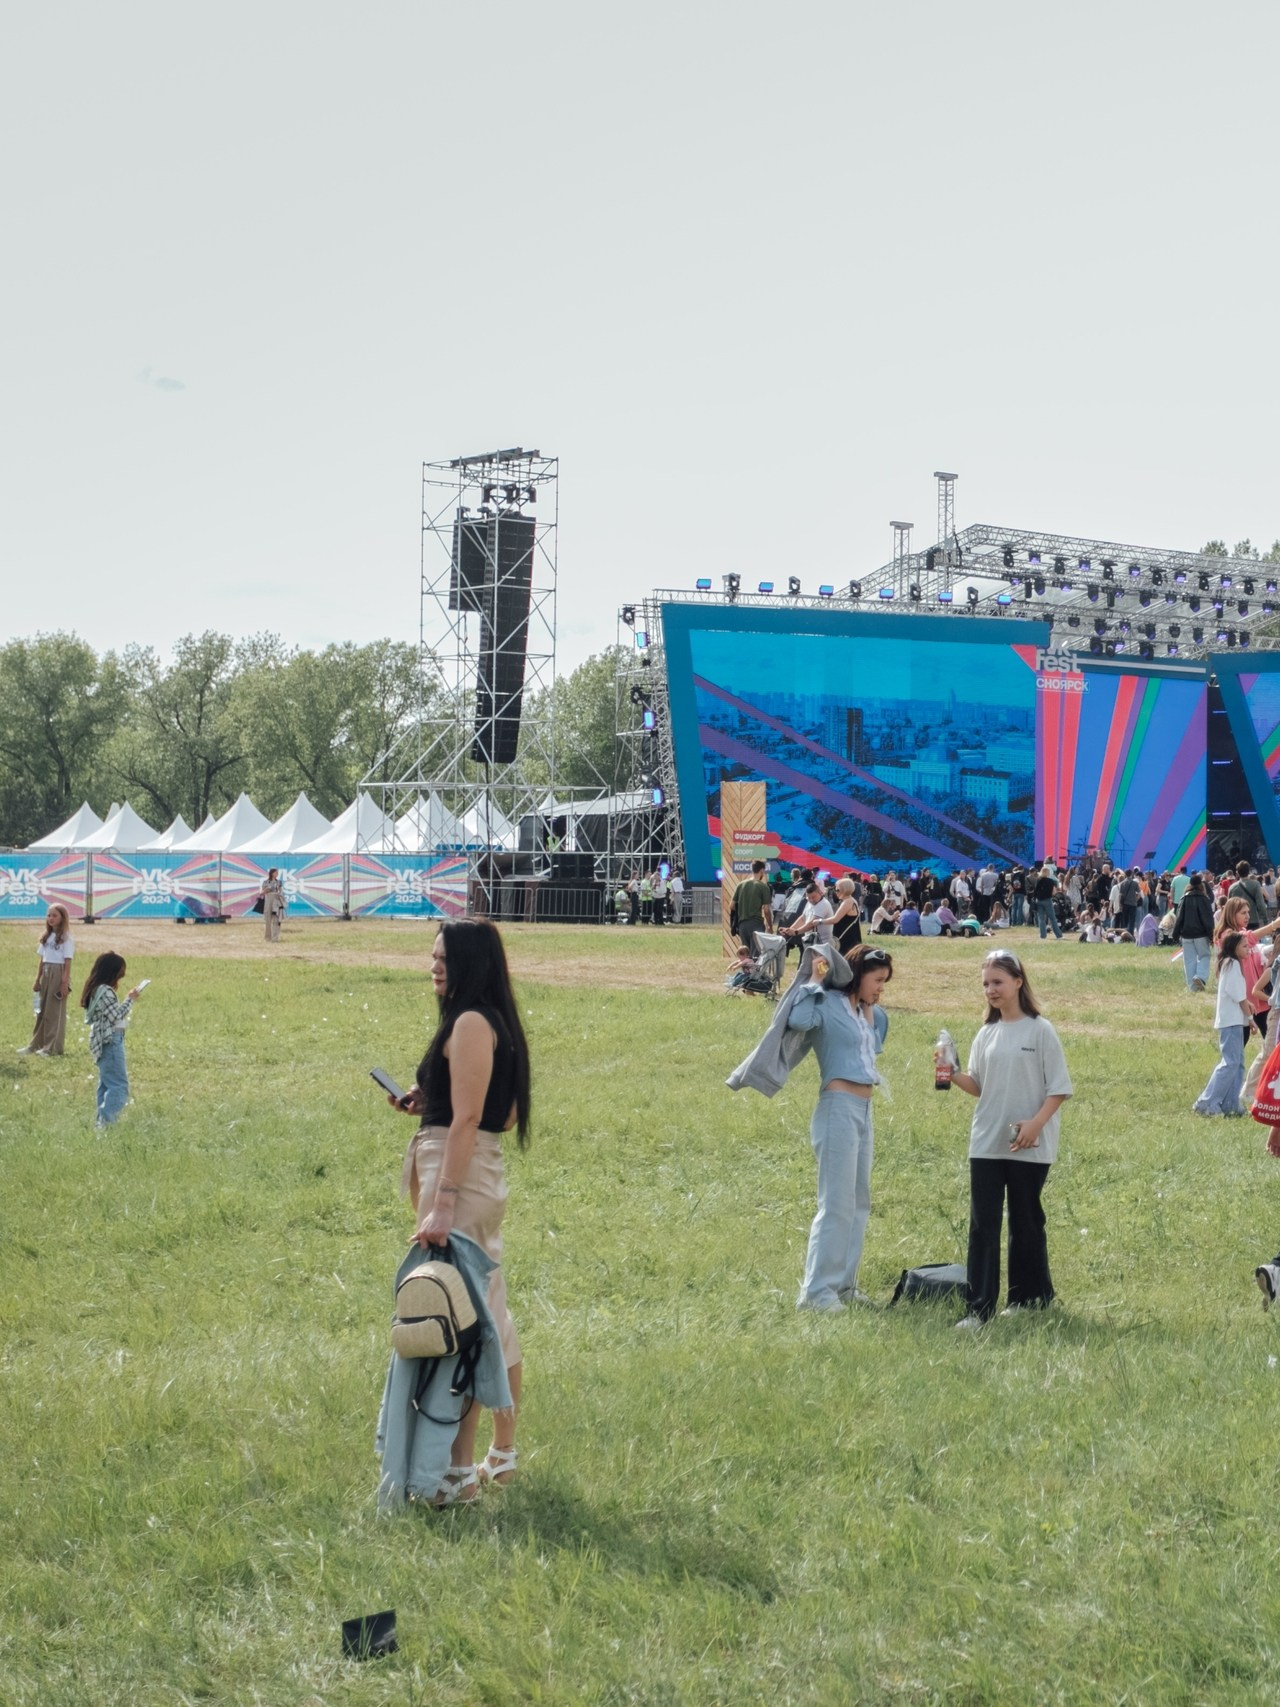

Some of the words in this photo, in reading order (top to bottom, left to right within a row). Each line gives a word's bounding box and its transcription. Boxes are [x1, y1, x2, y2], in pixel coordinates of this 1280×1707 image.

[1036, 649, 1081, 673] fest
[734, 833, 765, 841] ФУДКОРТ
[734, 863, 771, 871] КОСЙ
[8, 868, 39, 881] VK
[141, 868, 171, 881] VK
[395, 868, 424, 881] VK
[0, 877, 51, 896] fest
[132, 877, 185, 895] fest
[387, 877, 434, 895] fest
[9, 896, 38, 905] 2024
[142, 895, 171, 904] 2024
[395, 894, 422, 903] 2024
